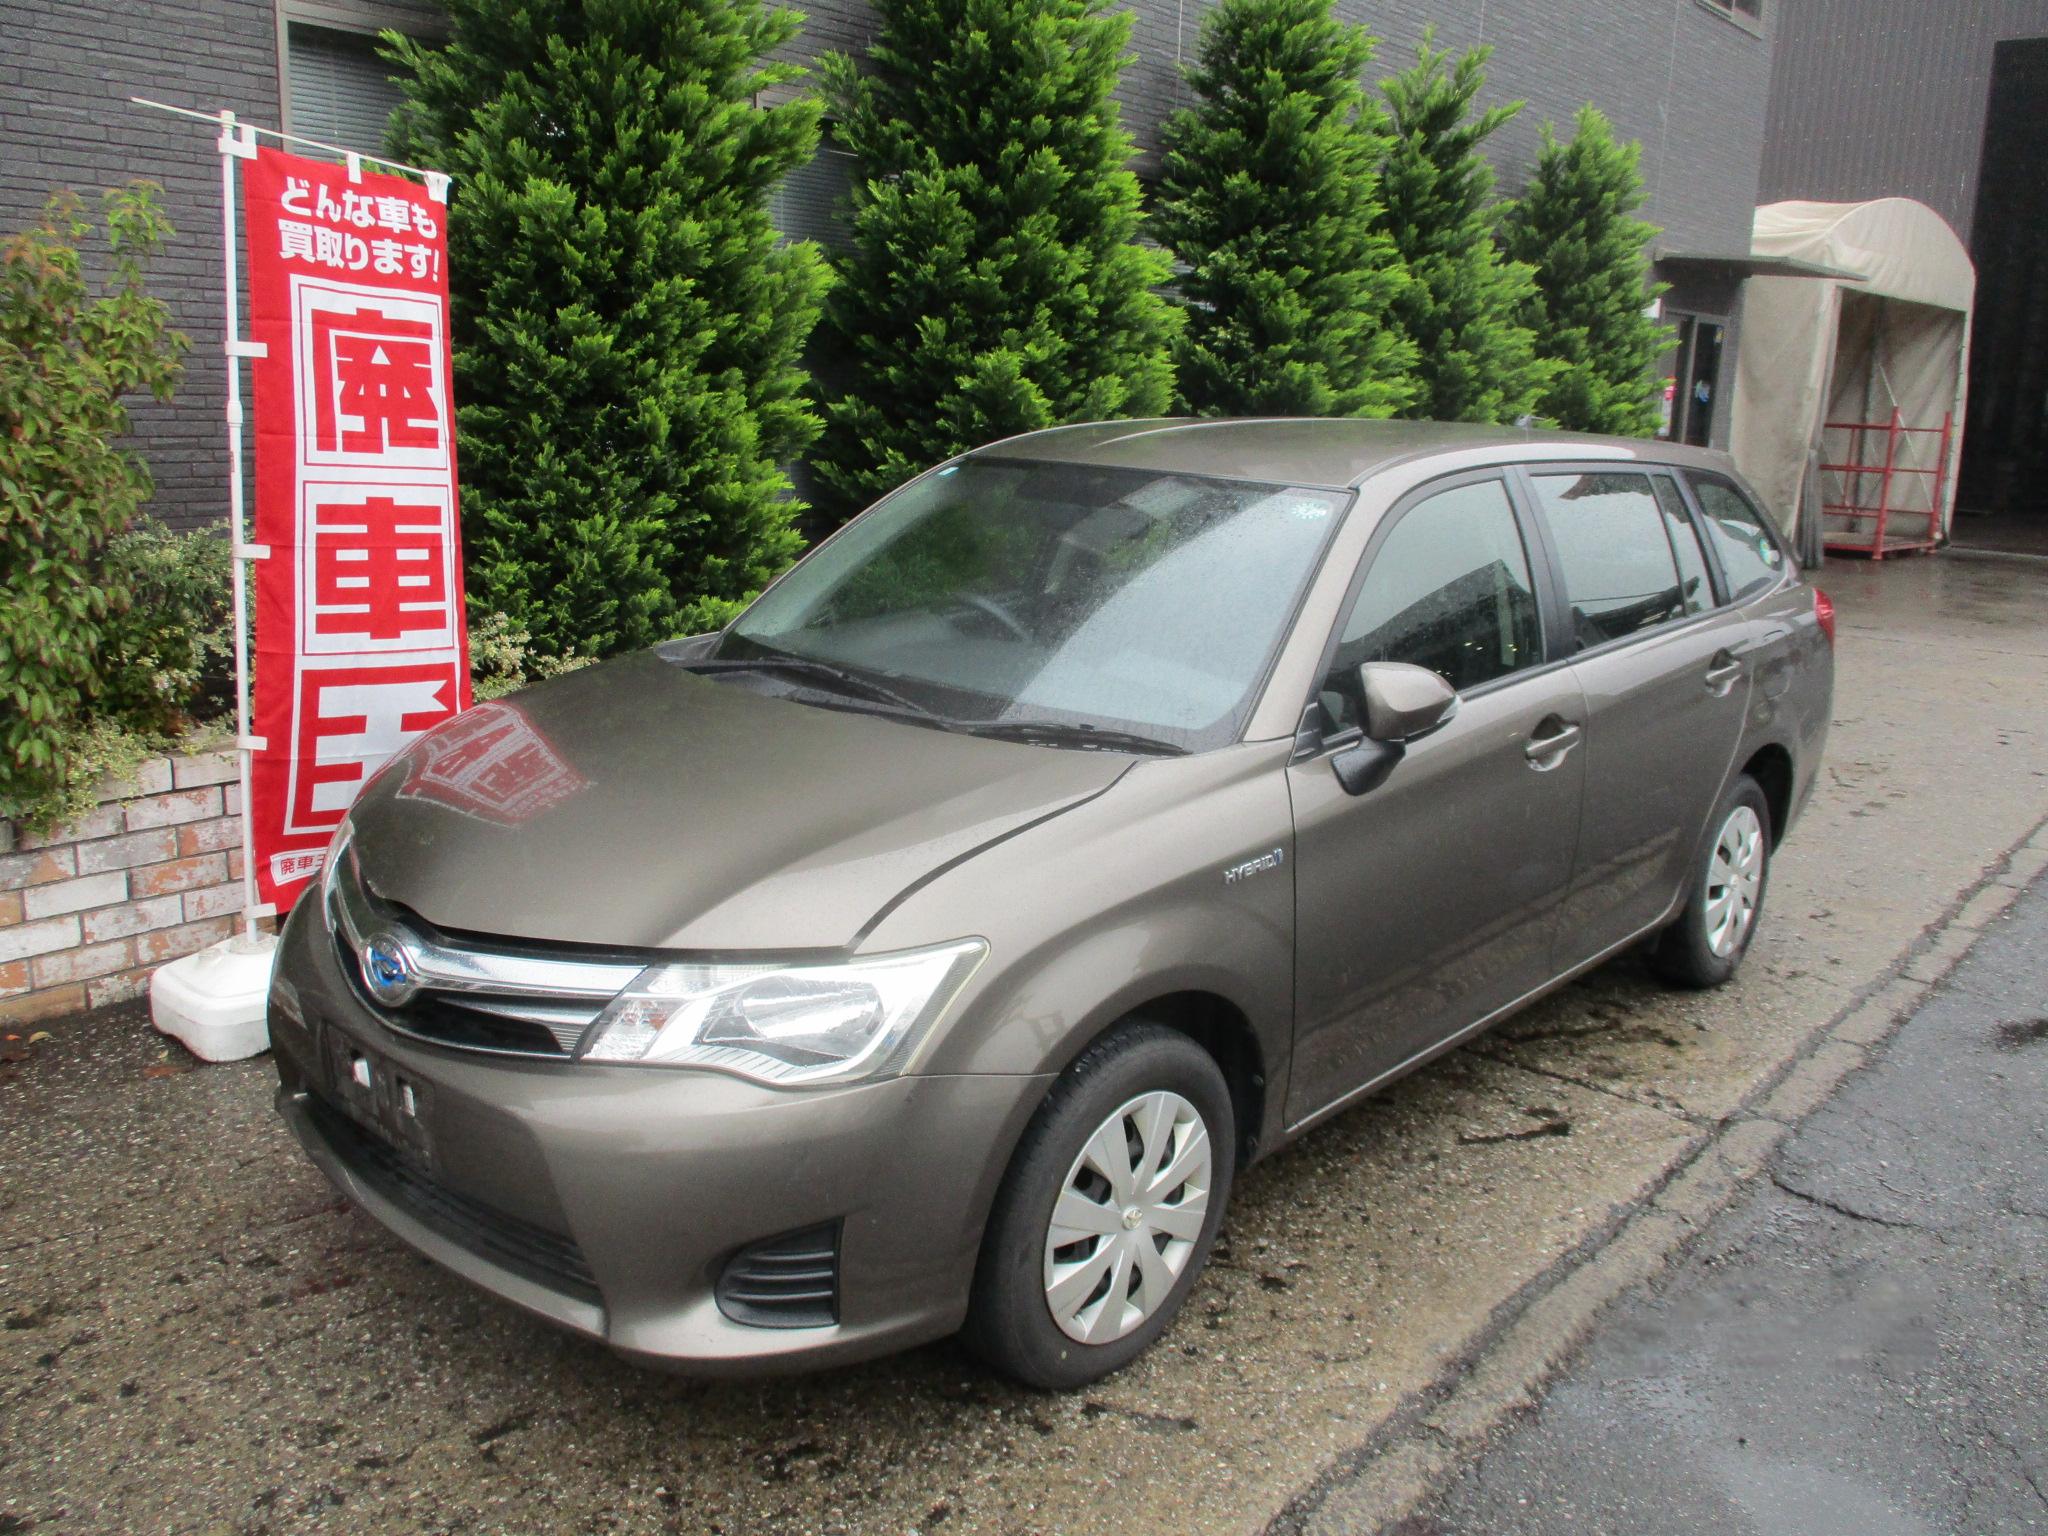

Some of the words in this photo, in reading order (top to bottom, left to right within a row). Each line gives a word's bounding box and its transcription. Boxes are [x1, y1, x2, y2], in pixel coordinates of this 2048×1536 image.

[280, 176, 438, 239] どんな車も
[277, 218, 440, 283] 買取ります!
[1225, 854, 1274, 884] HYBRID
